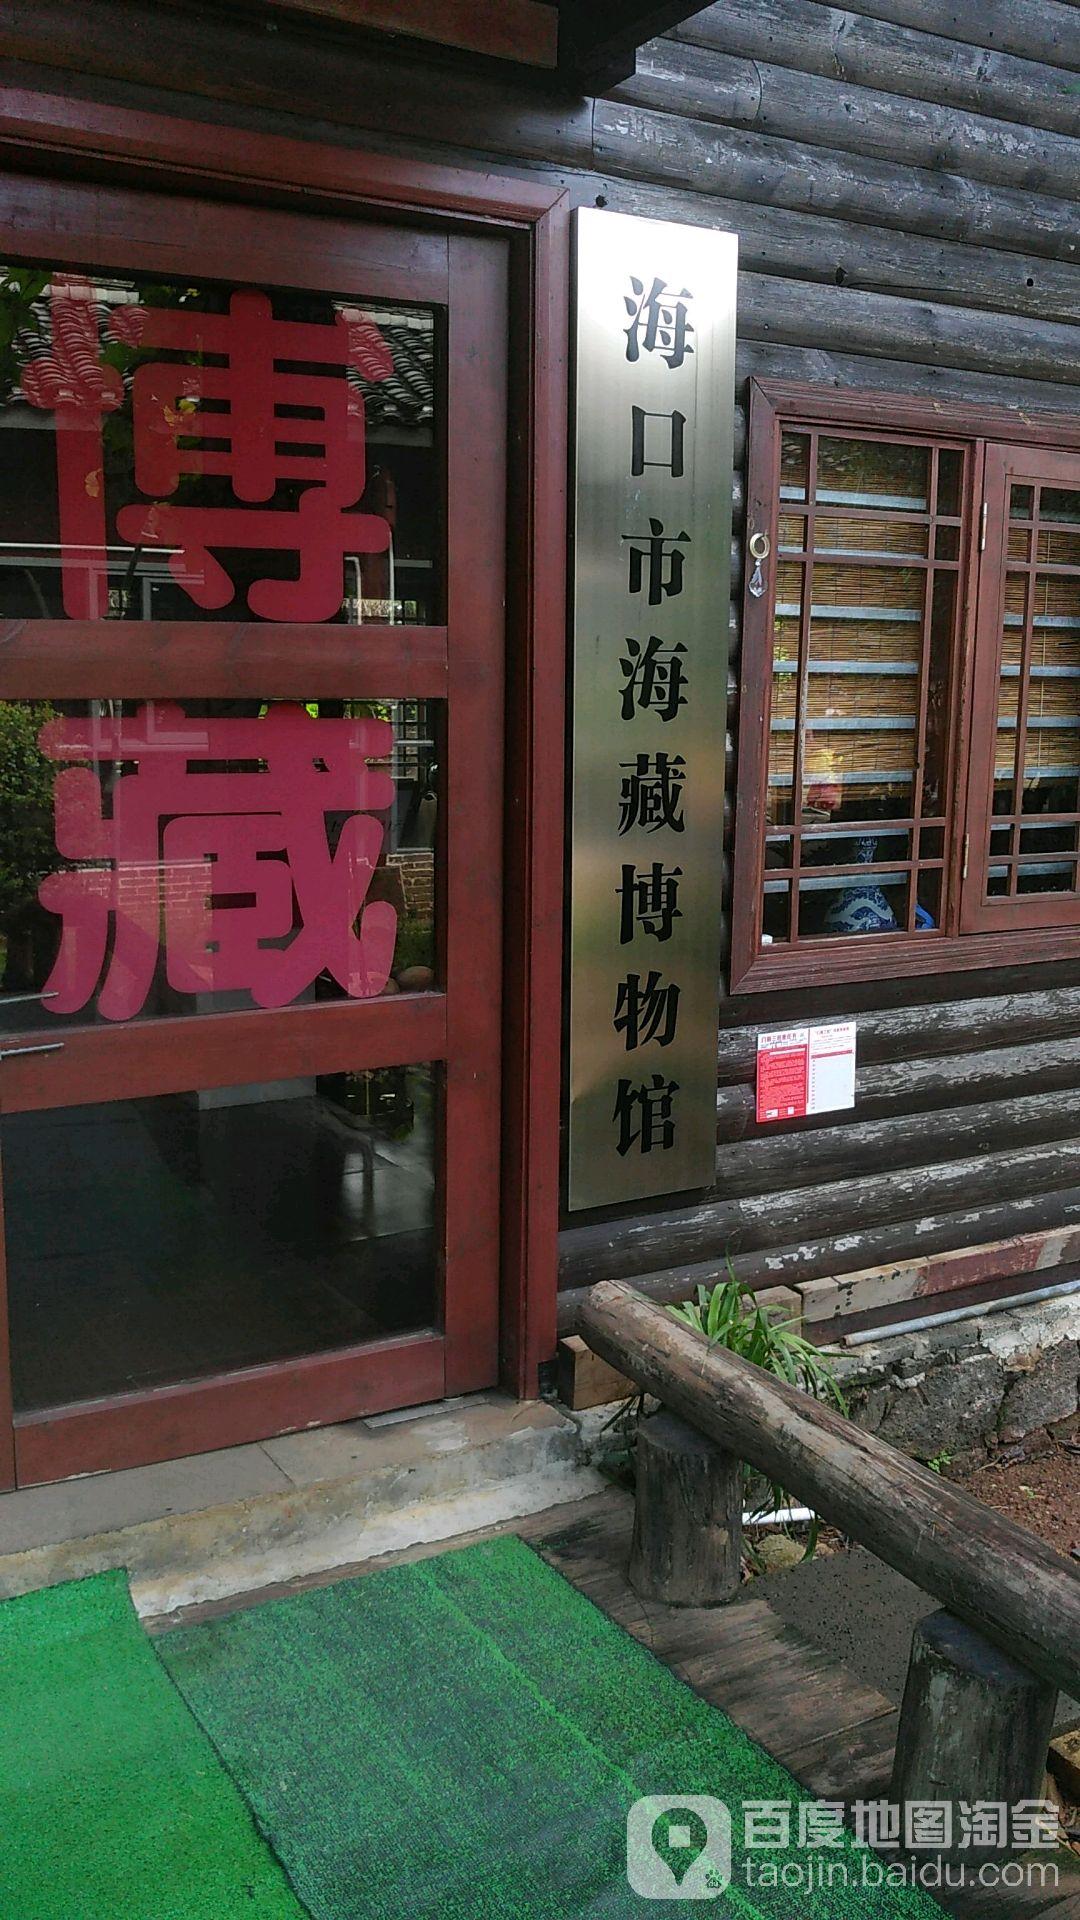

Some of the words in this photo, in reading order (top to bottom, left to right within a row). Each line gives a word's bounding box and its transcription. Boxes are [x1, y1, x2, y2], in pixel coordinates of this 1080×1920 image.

[613, 275, 695, 1157] 海口市海藏博物馆
